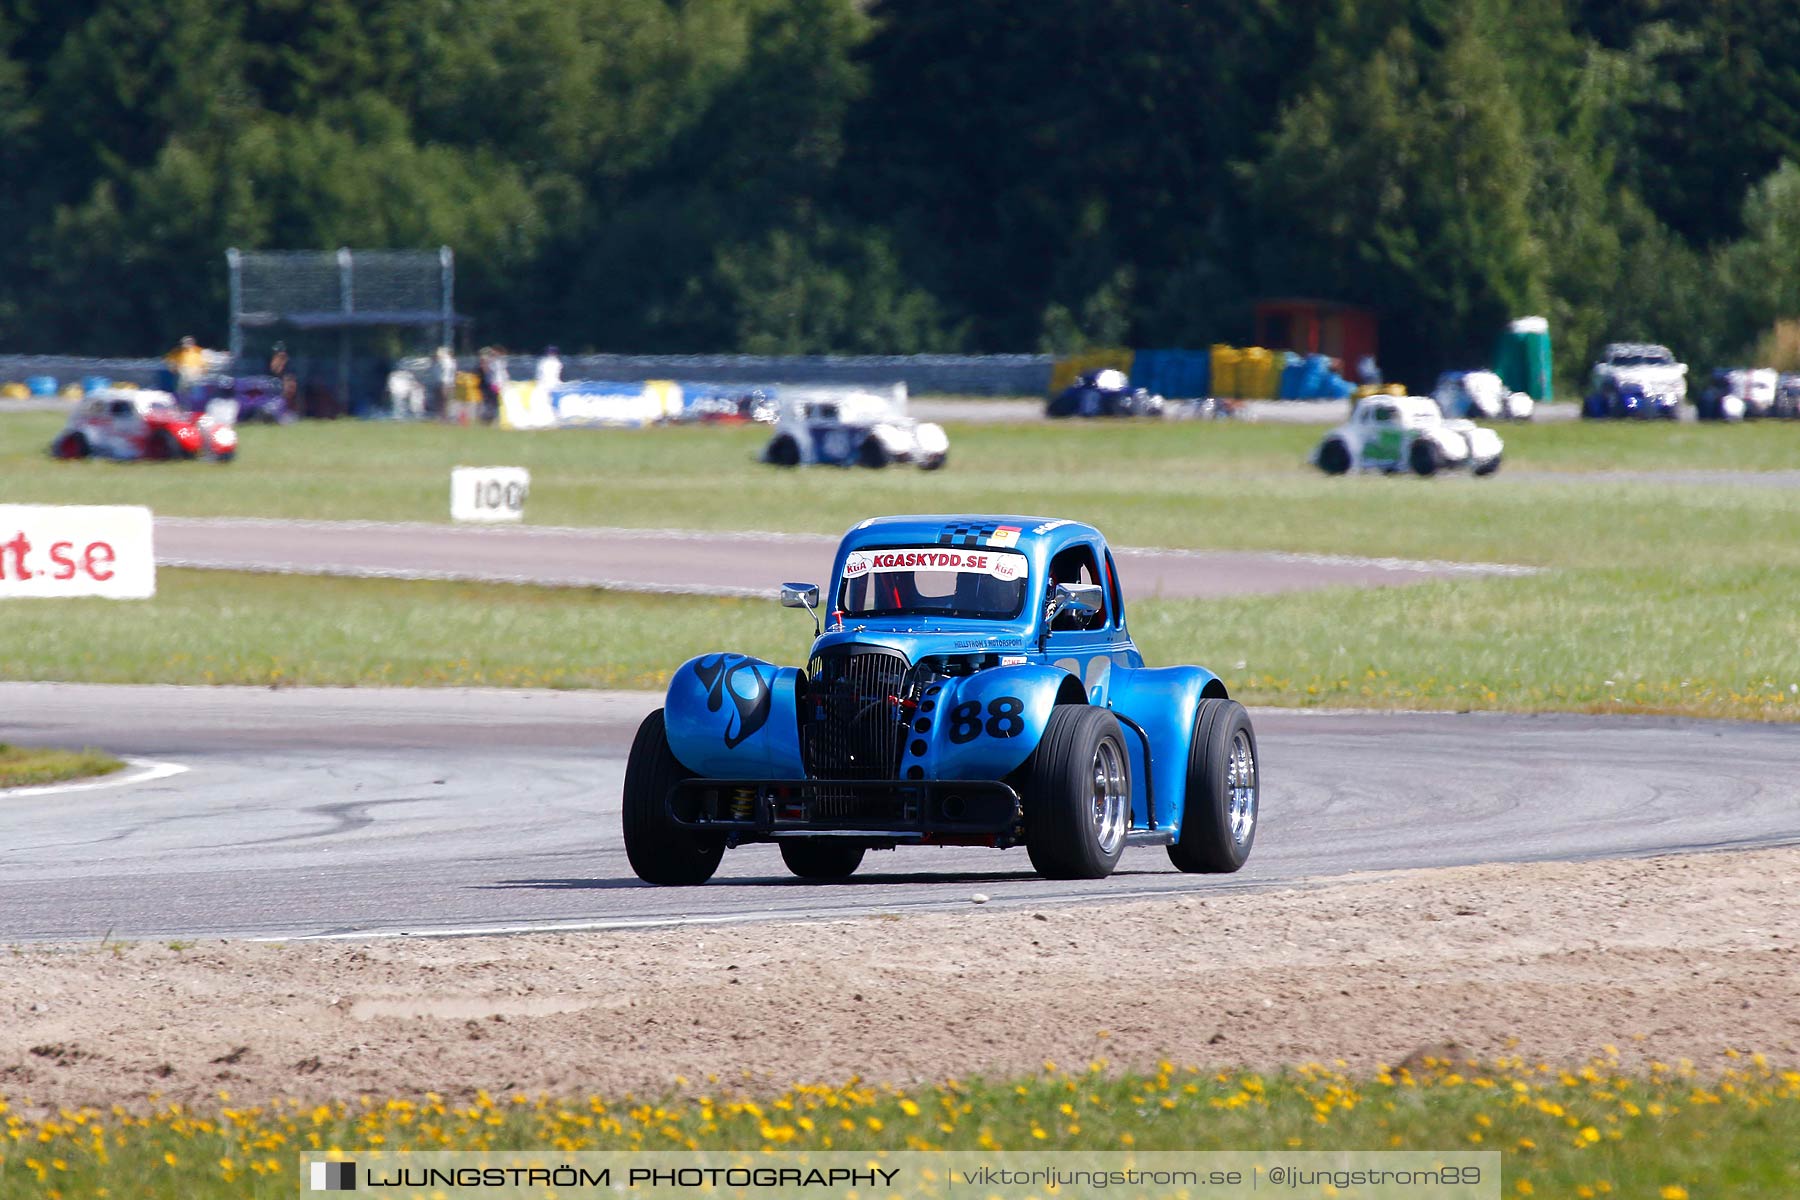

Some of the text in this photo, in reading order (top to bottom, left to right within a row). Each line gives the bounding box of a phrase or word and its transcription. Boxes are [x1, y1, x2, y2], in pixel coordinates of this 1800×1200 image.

[474, 478, 527, 512] 100
[0, 530, 115, 581] t.se
[846, 561, 867, 574] KGA
[872, 553, 988, 569] KGASKYDD.SE
[994, 562, 1014, 576] KGA
[948, 695, 1025, 744] 88
